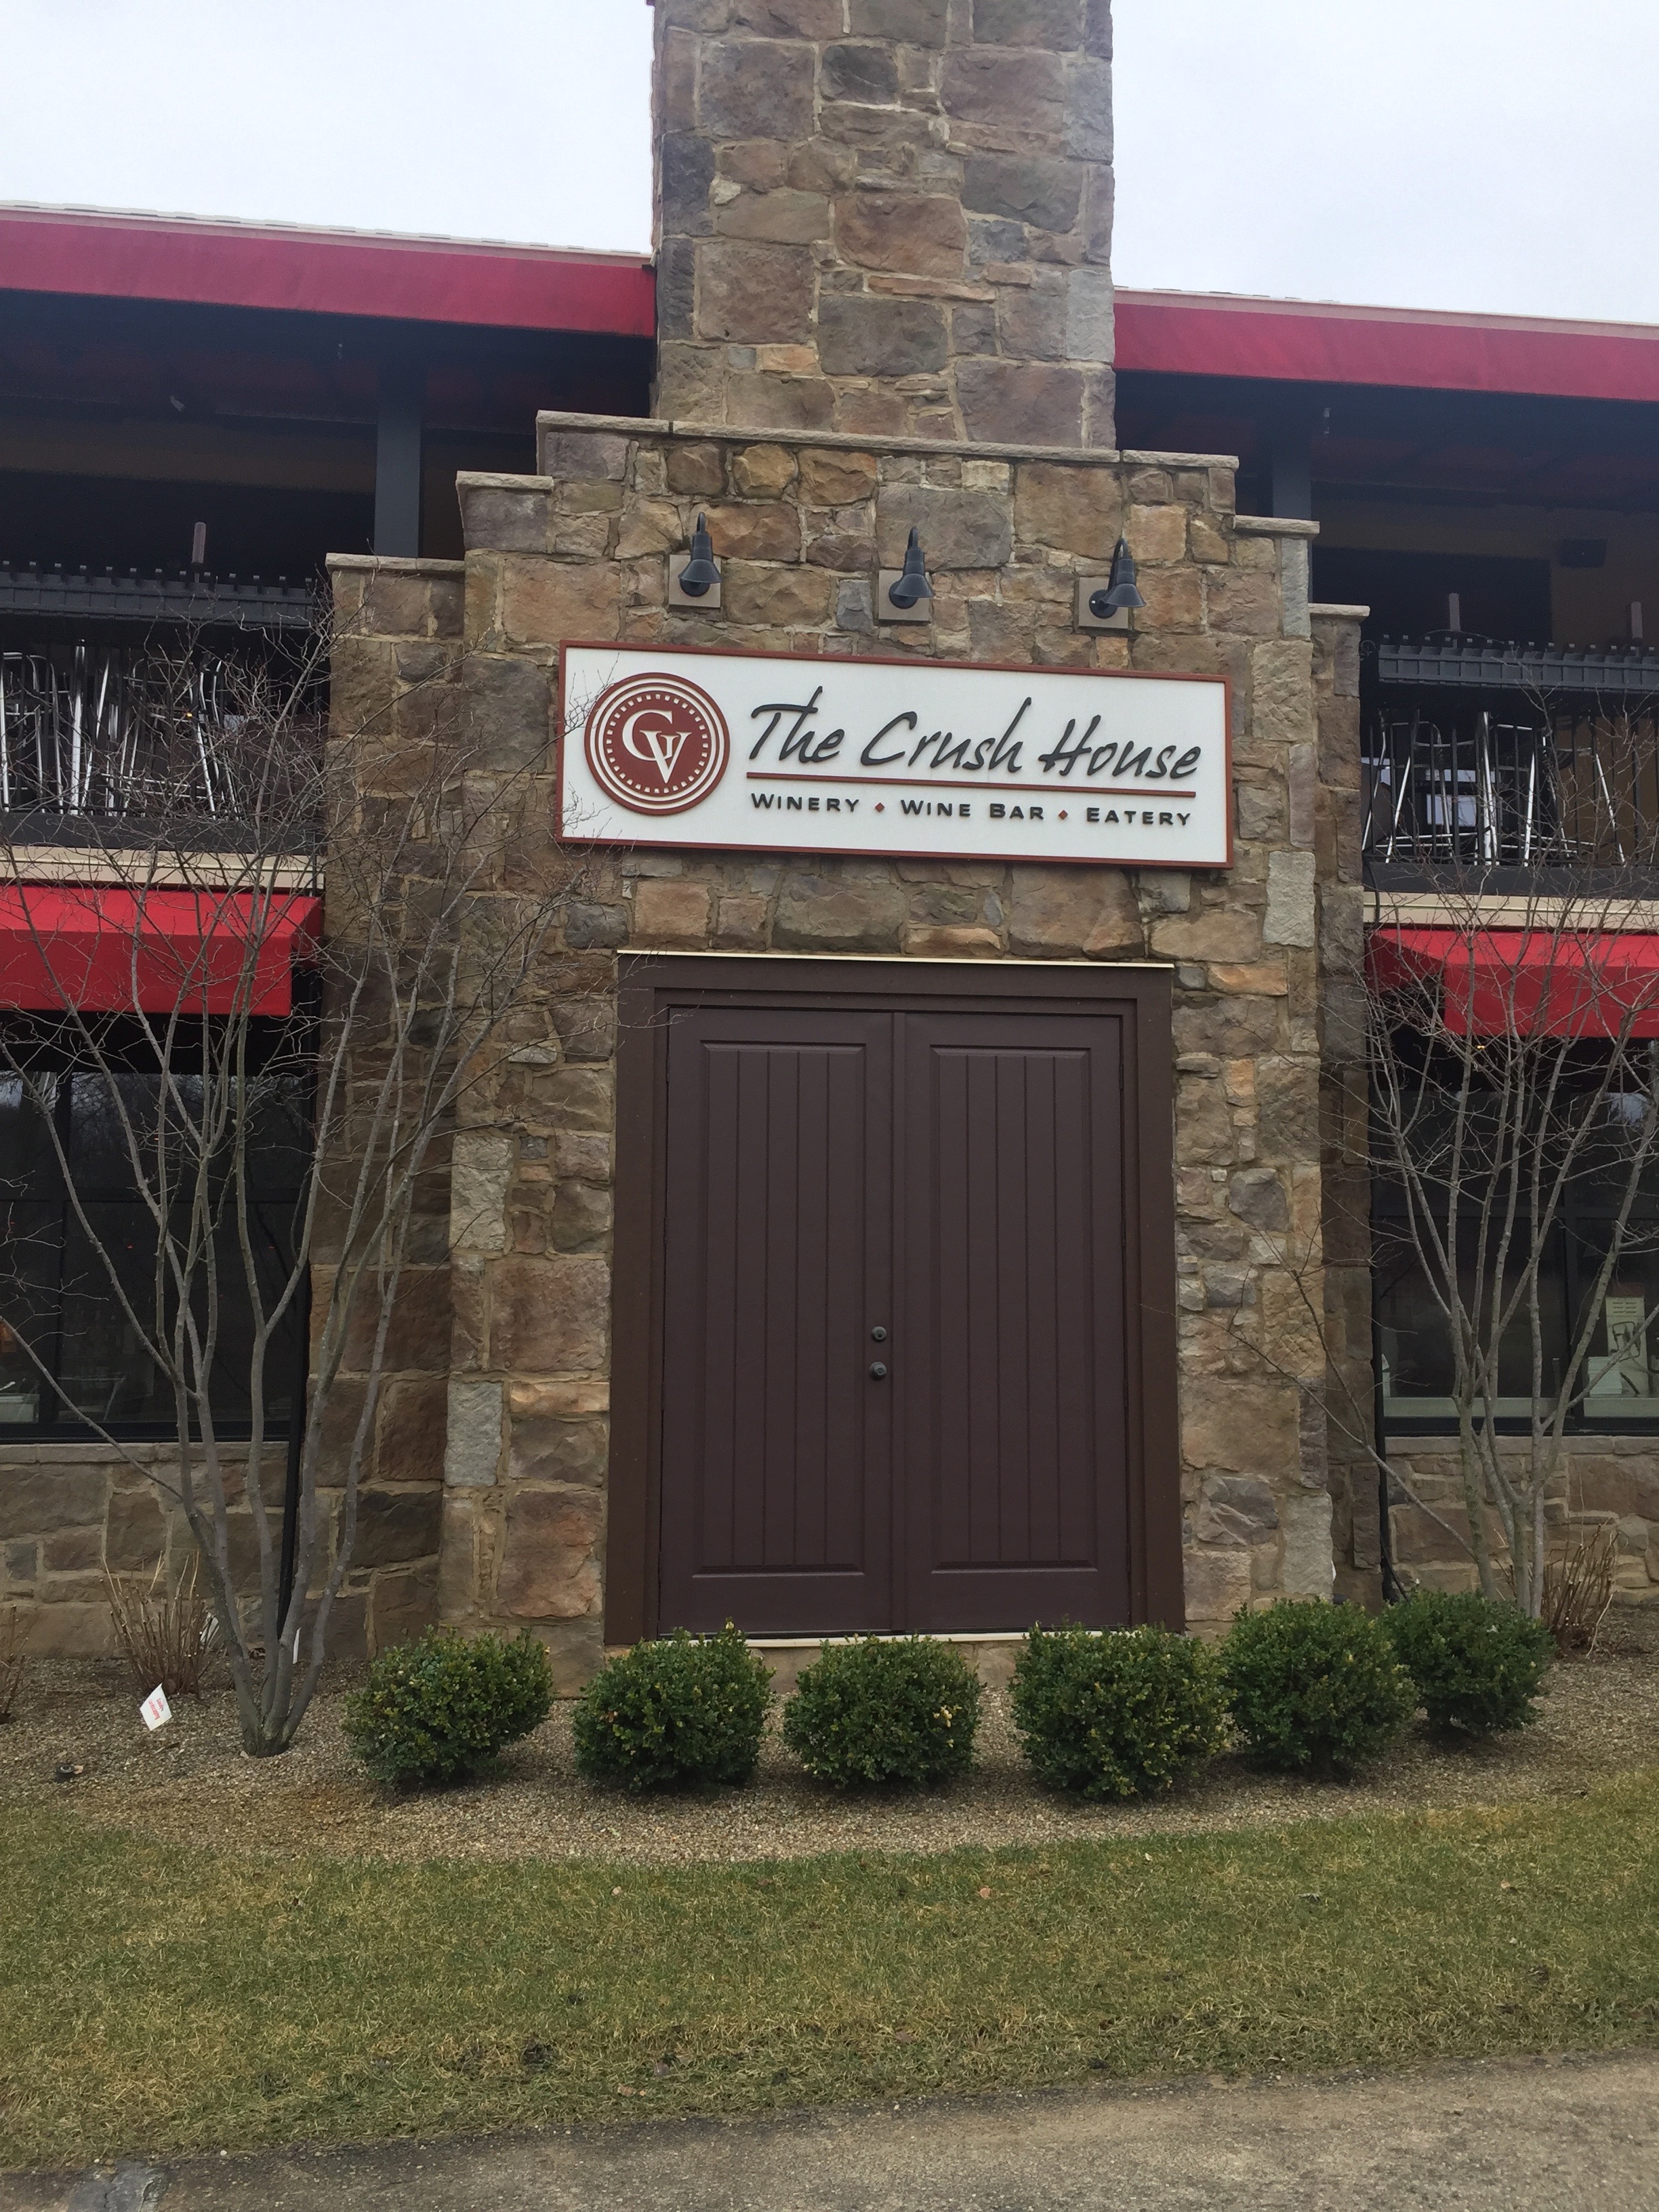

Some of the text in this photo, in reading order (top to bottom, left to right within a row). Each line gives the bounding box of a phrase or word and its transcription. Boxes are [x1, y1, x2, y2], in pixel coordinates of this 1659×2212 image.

[750, 685, 1202, 781] The Crush House
[750, 792, 1191, 827] WINERY WINE BAR EATERY
